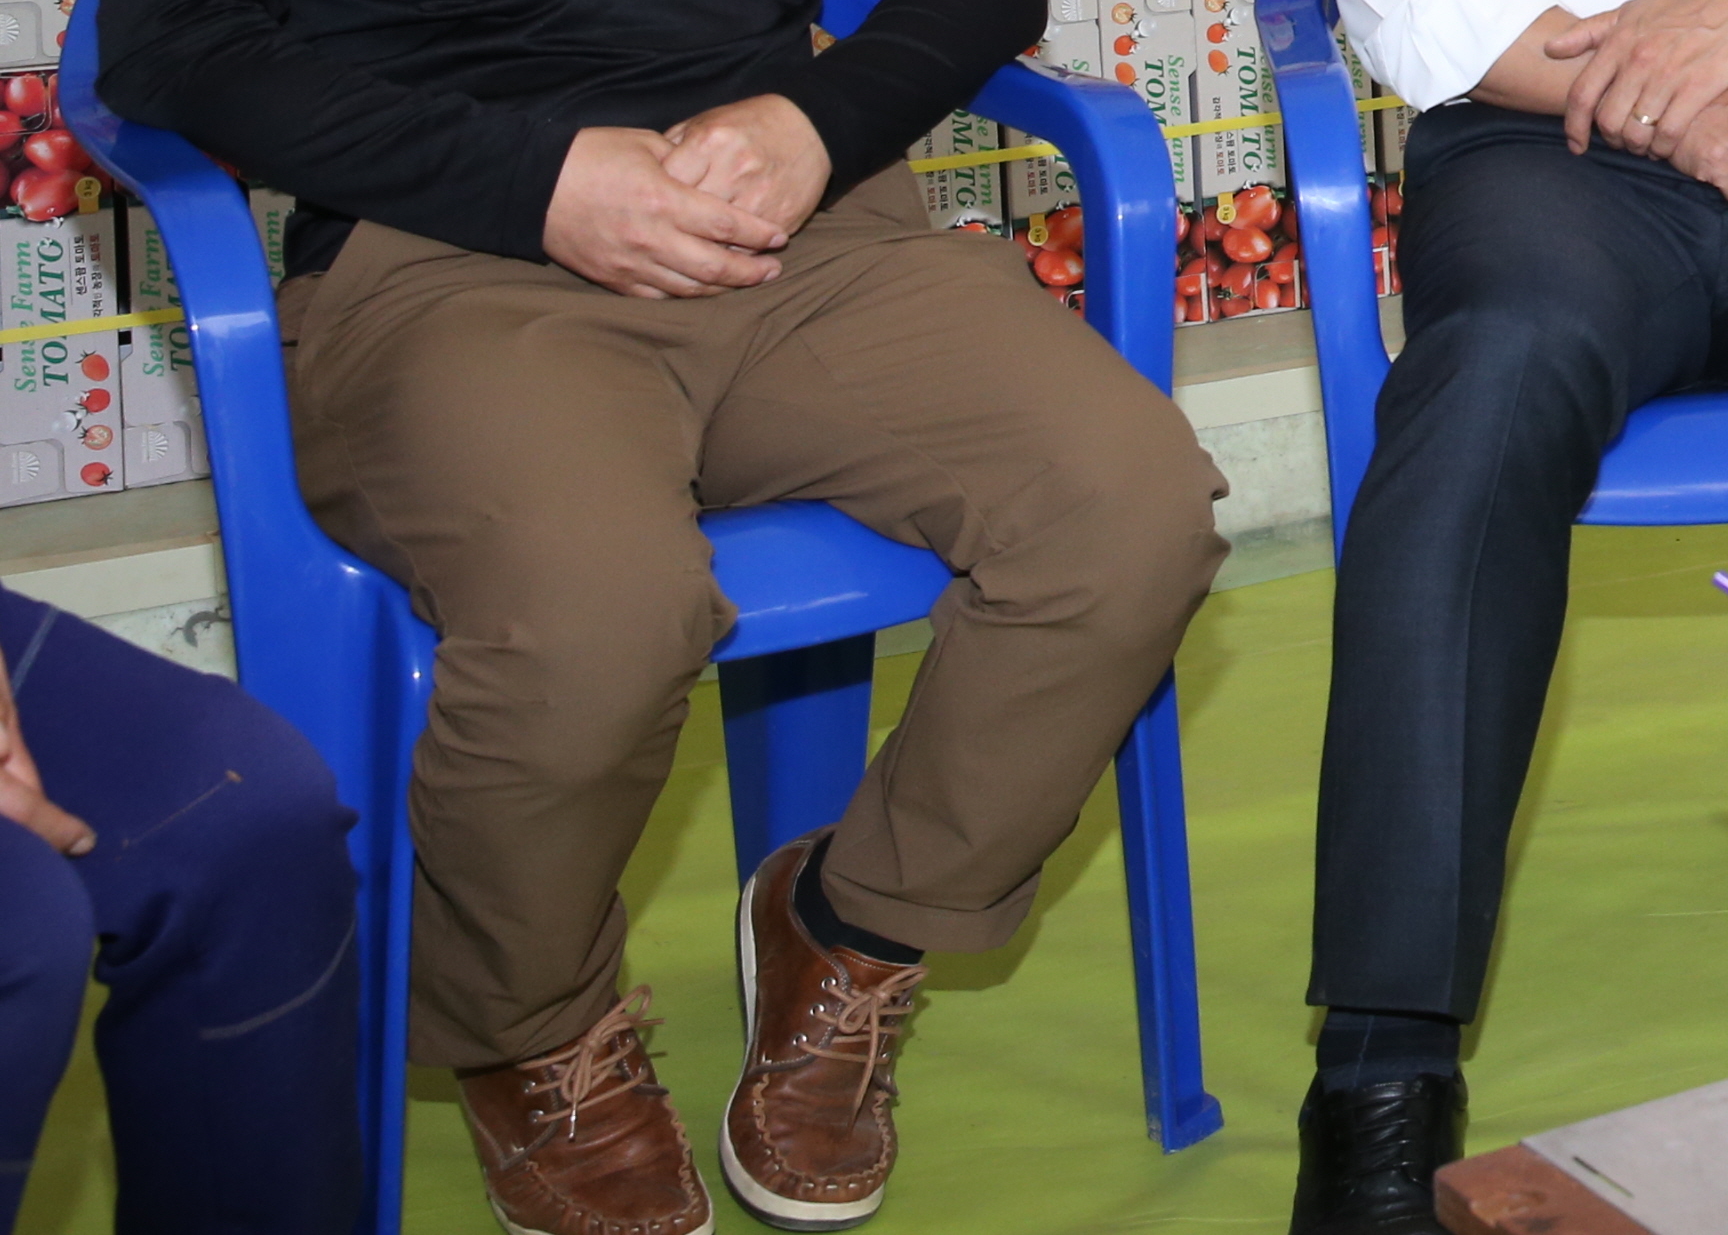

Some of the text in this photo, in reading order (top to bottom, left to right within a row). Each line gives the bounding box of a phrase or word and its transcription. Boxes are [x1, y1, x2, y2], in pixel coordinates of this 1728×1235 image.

[1168, 55, 1184, 116] Sense
[11, 241, 33, 311] Farm
[74, 233, 87, 295] 센스팜 토마토
[90, 235, 100, 260] 토마토
[140, 228, 162, 296] Farm
